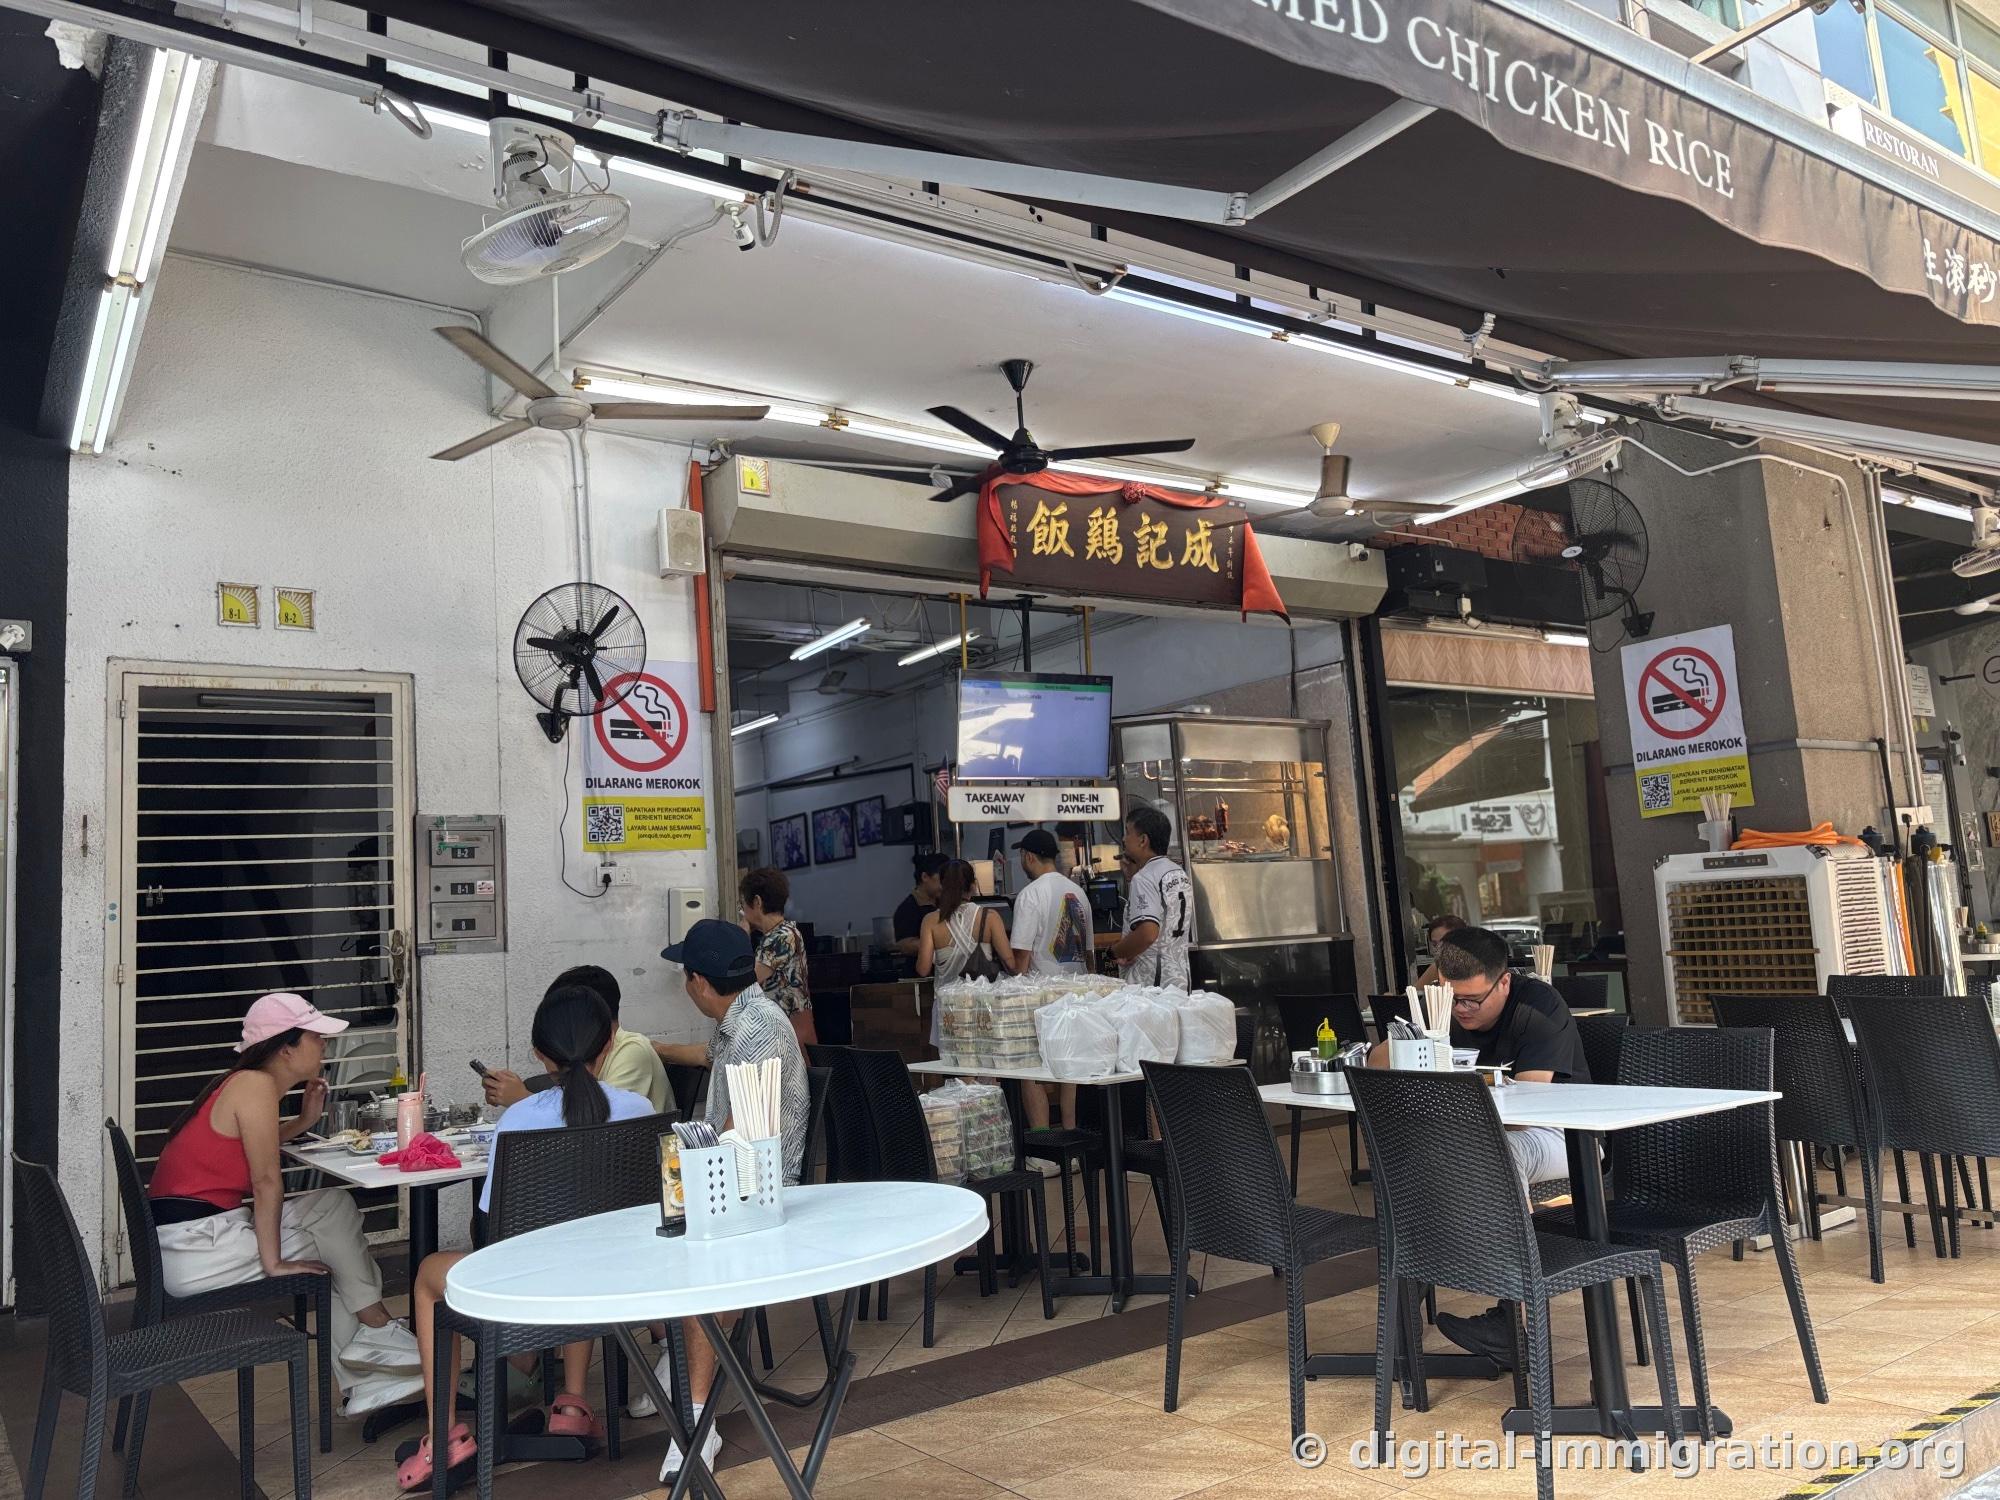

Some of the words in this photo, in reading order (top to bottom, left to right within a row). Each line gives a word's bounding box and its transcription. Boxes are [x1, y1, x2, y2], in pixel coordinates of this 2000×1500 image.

[1406, 16, 1630, 155] CHICKEN
[1645, 118, 1734, 199] RICE
[1863, 119, 1940, 179] RESTORAN
[228, 608, 241, 619] 8-1
[284, 612, 297, 624] 8-2
[1636, 745, 1686, 762] DILARANG
[1688, 736, 1743, 753] MEROKOK
[585, 777, 643, 789] DILARANG
[645, 778, 701, 790] MEROKOK
[965, 793, 1025, 803] TAKEAWAY
[1061, 793, 1099, 803] DINE-IN
[981, 805, 1011, 815] ONLY
[1057, 805, 1105, 815] PAYMENT
